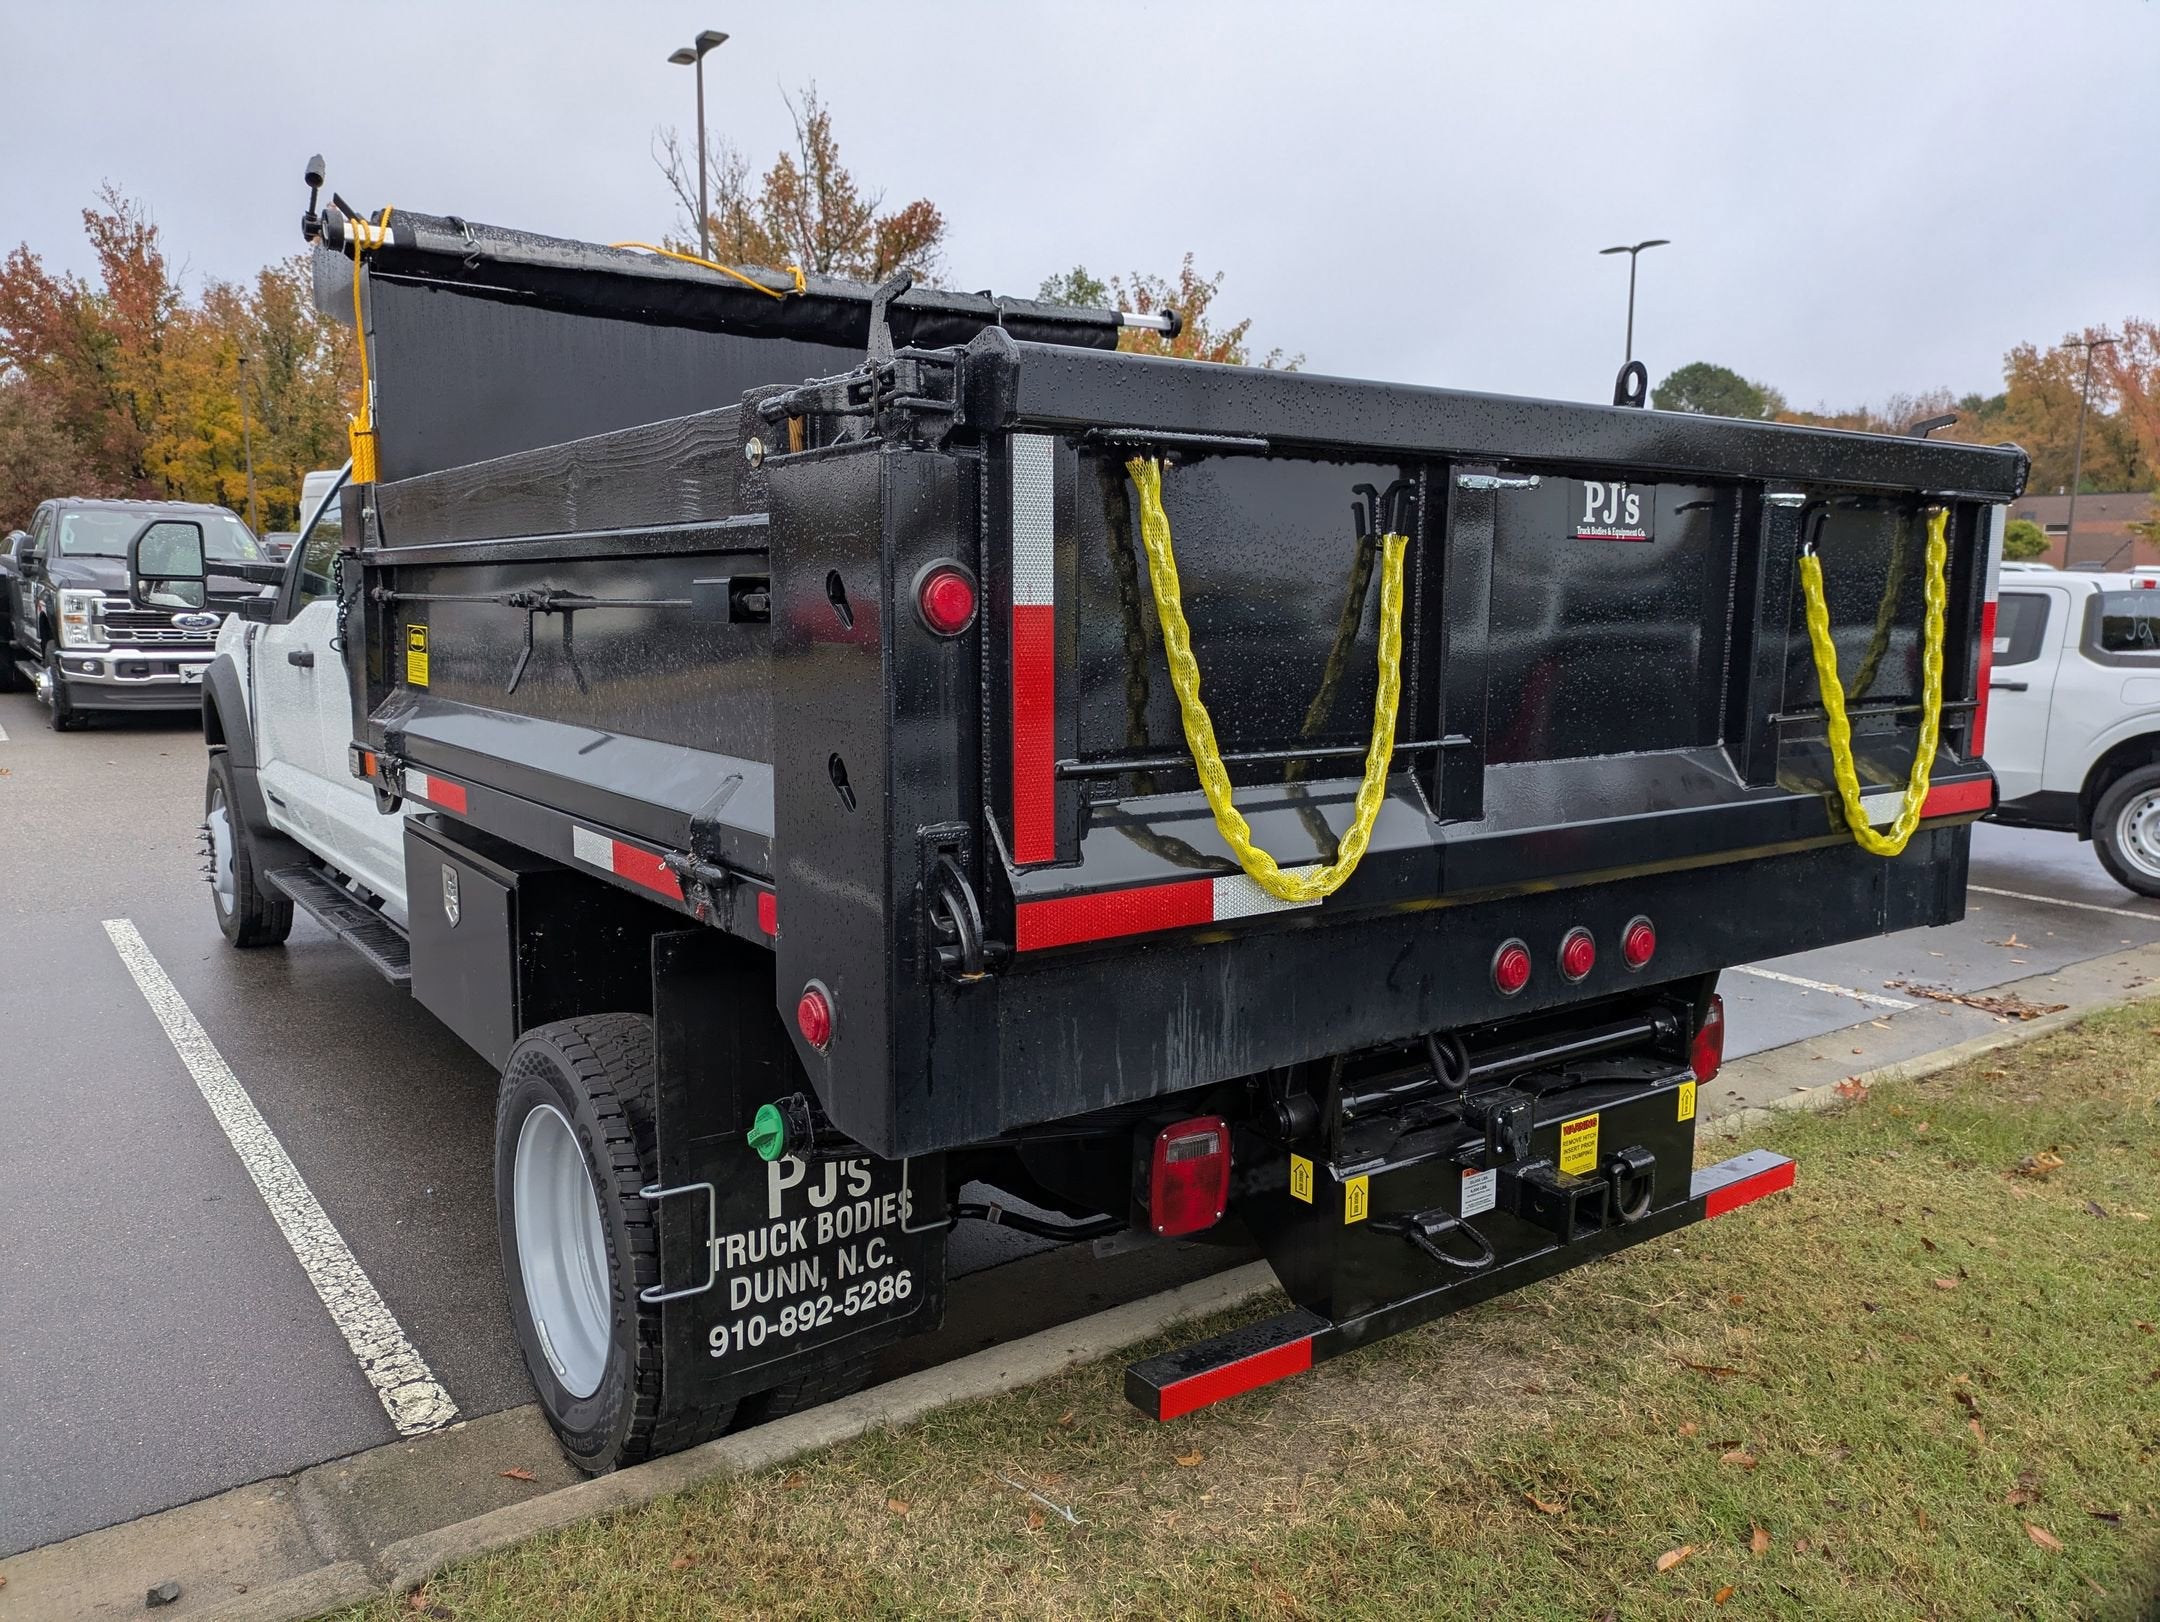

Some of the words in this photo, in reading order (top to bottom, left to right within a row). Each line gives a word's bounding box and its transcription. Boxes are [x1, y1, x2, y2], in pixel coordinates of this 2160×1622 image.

[1583, 480, 1640, 525] PJ's
[185, 616, 207, 626] Ford
[1563, 1117, 1597, 1136] WARNING
[1563, 1136, 1582, 1147] REMOVE
[1583, 1133, 1596, 1141] HITCH
[1564, 1145, 1580, 1154] INSERT
[1581, 1141, 1595, 1149] PRIOR
[1572, 1149, 1593, 1160] DUMPING
[768, 1154, 872, 1219] PJ'S
[706, 1218, 808, 1272] TRUCK
[817, 1188, 913, 1245] BODIES
[730, 1256, 828, 1311] DUNN,
[838, 1237, 893, 1280] N.C.
[709, 1270, 912, 1357] 910-892-5286
